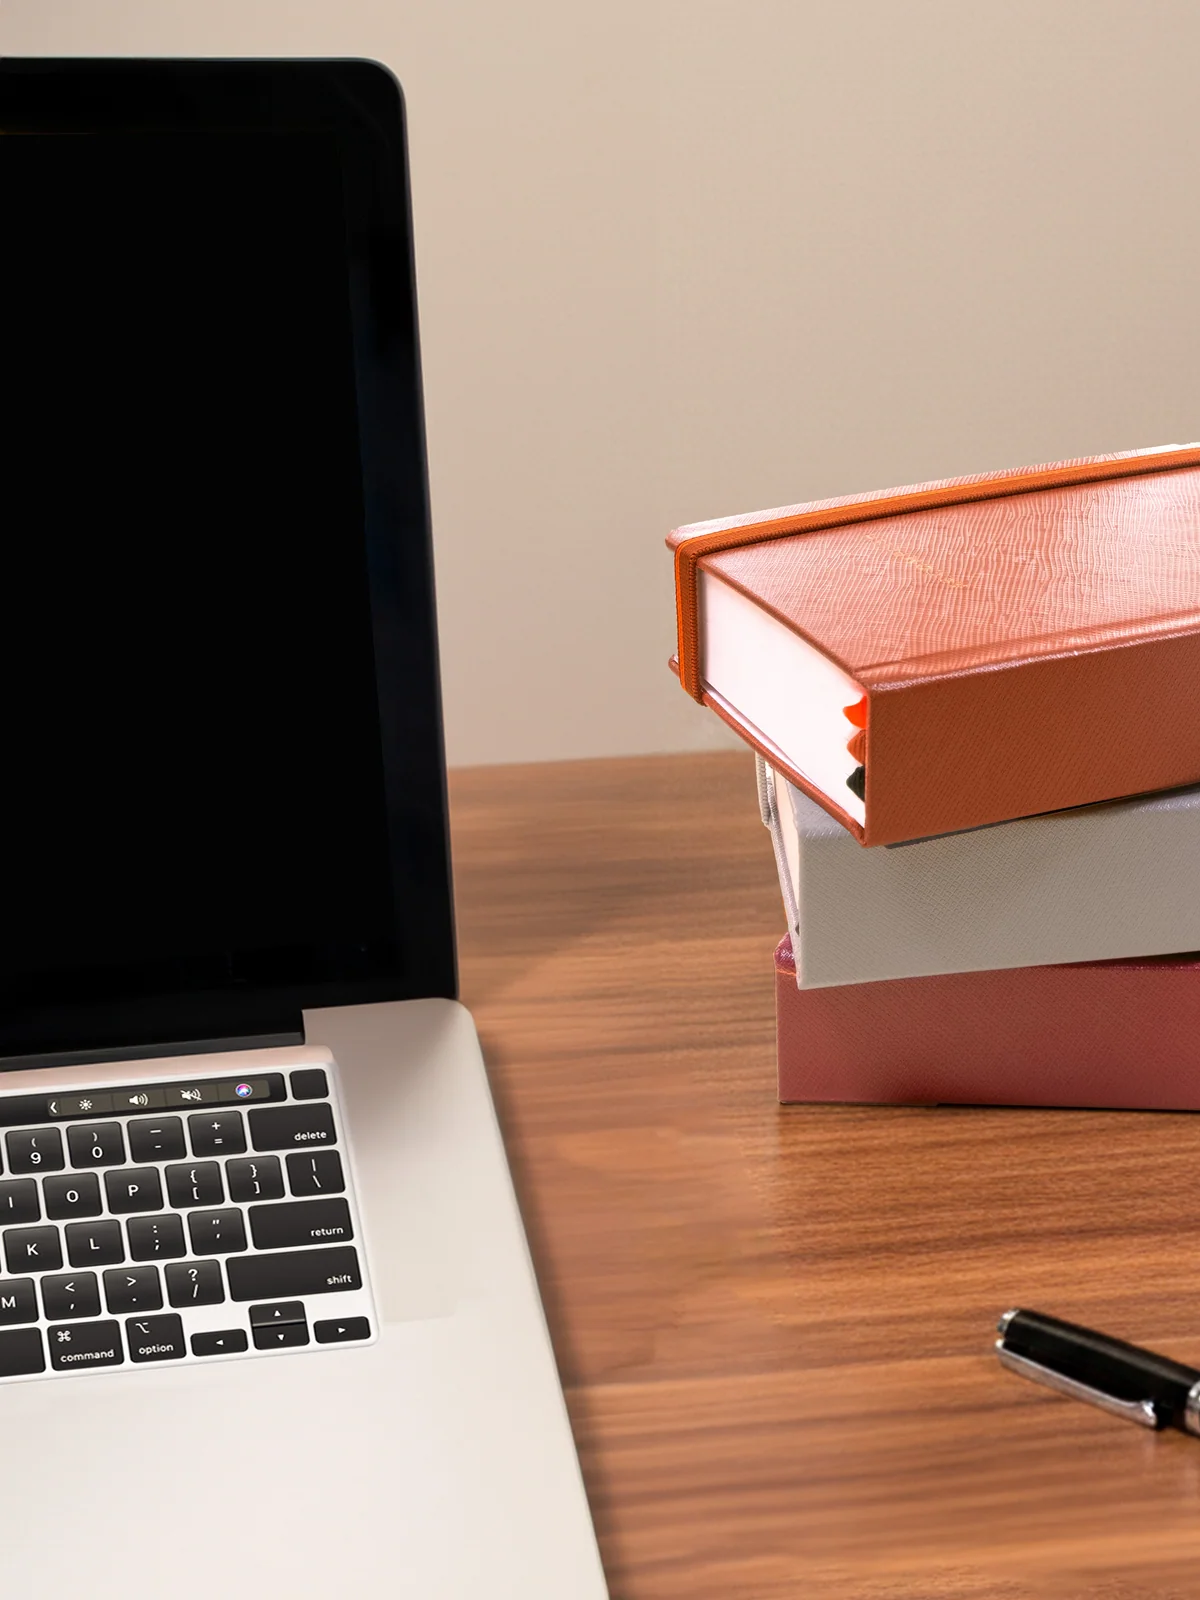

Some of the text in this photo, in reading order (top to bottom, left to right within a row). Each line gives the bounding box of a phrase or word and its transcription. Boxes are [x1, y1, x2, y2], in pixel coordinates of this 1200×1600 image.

[293, 1129, 328, 1142] delete
[30, 1151, 42, 1165] 9
[66, 1189, 79, 1203] O
[127, 1184, 139, 1197] P
[310, 1225, 344, 1237] return
[26, 1243, 39, 1256] K
[89, 1237, 100, 1250] L
[187, 1267, 198, 1282] ?
[326, 1273, 353, 1286] shift
[1, 1295, 16, 1309] M
[138, 1341, 174, 1355] option
[60, 1348, 115, 1363] command
